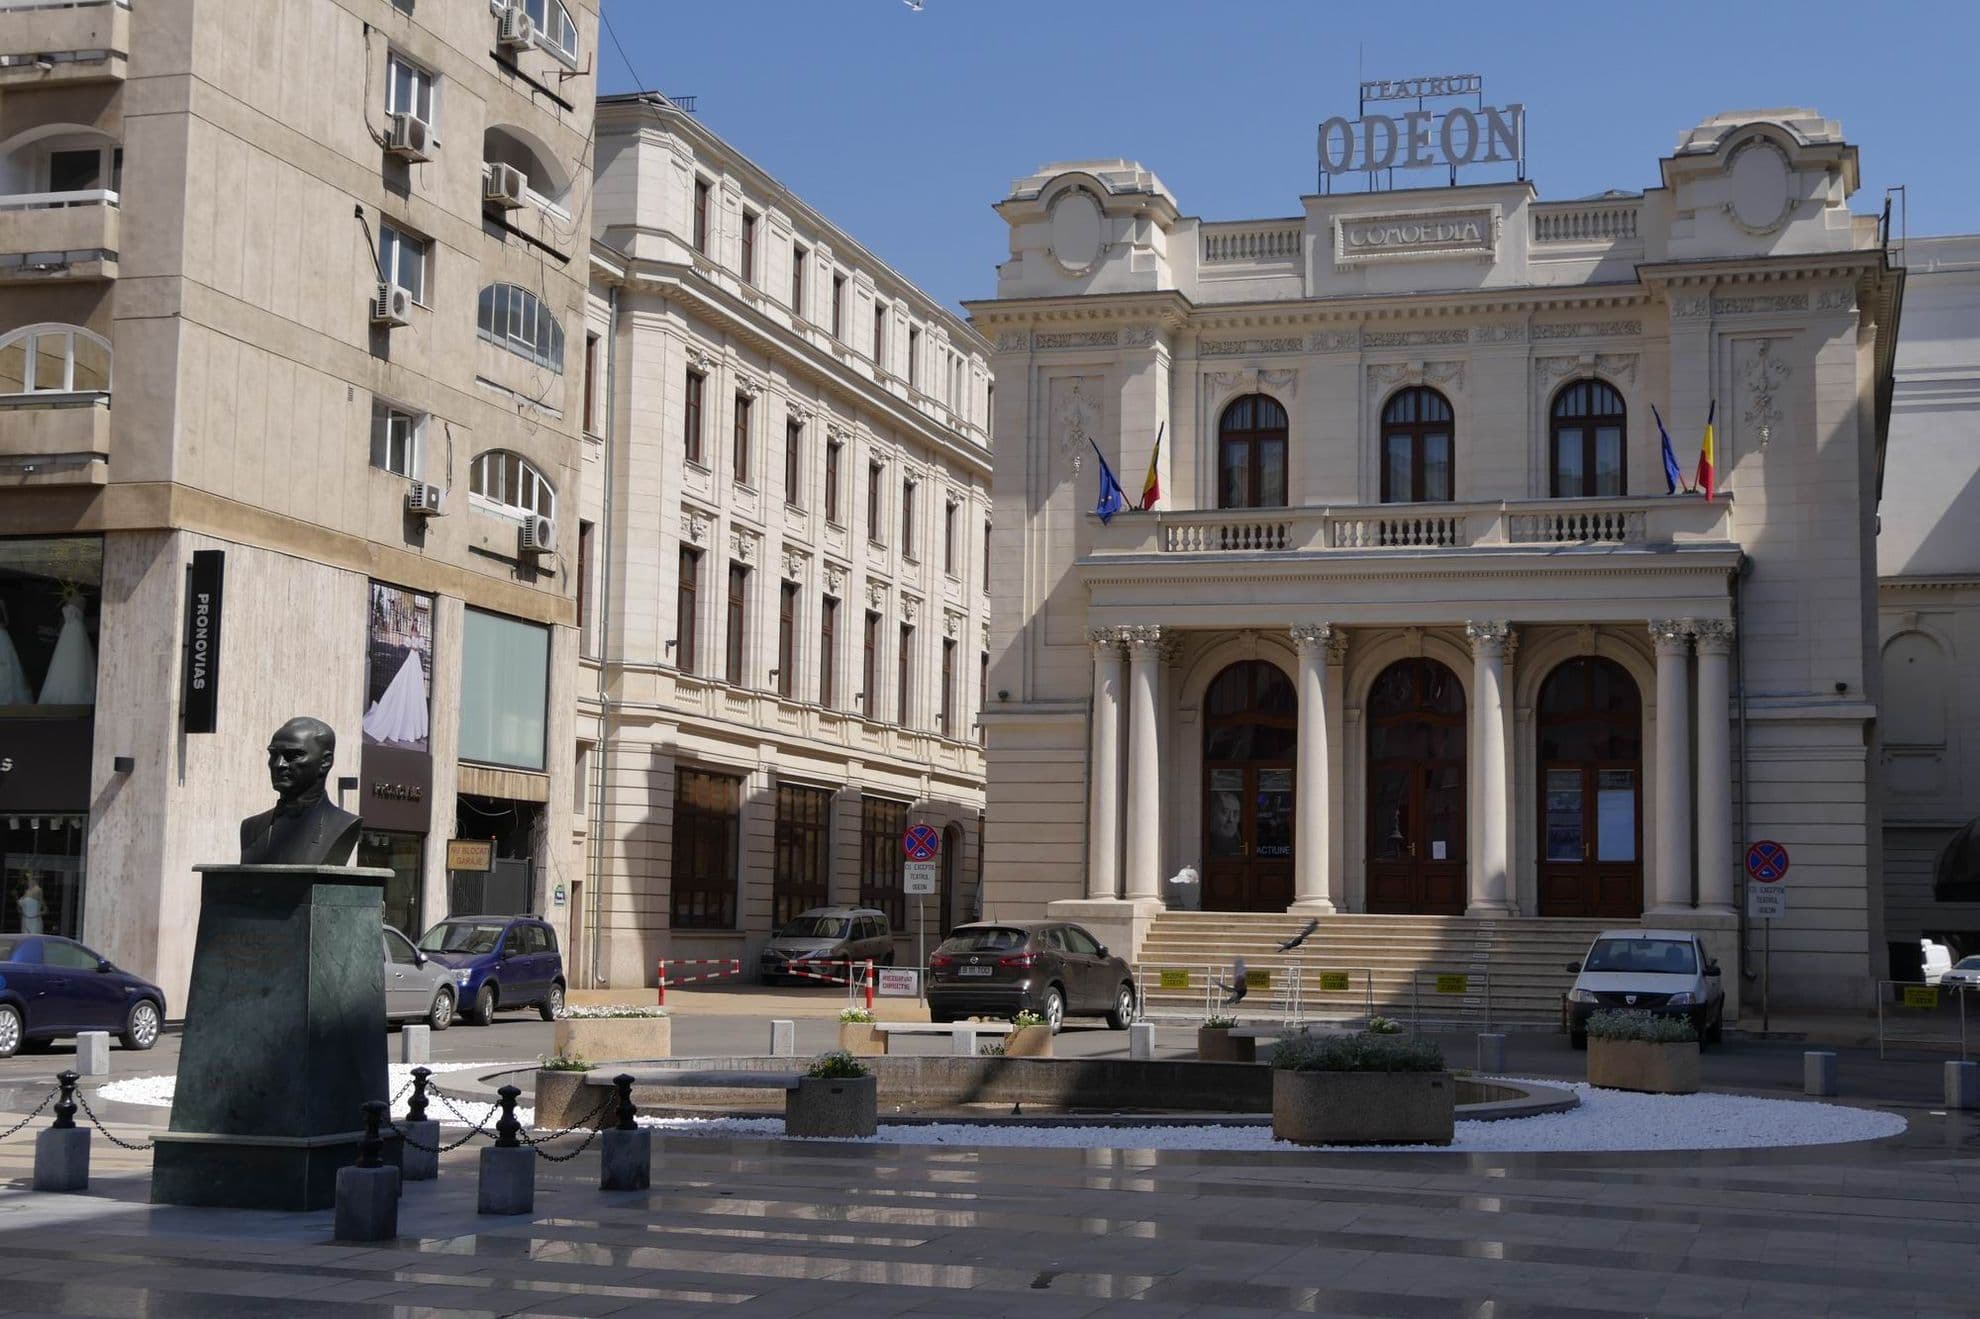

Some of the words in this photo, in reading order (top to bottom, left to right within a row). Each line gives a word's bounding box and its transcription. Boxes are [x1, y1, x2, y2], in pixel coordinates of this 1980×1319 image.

[1361, 73, 1481, 100] TEATRUL
[1317, 104, 1524, 175] ODEON
[1350, 221, 1482, 247] COMOEDIA
[193, 593, 209, 690] PRONOVIAS
